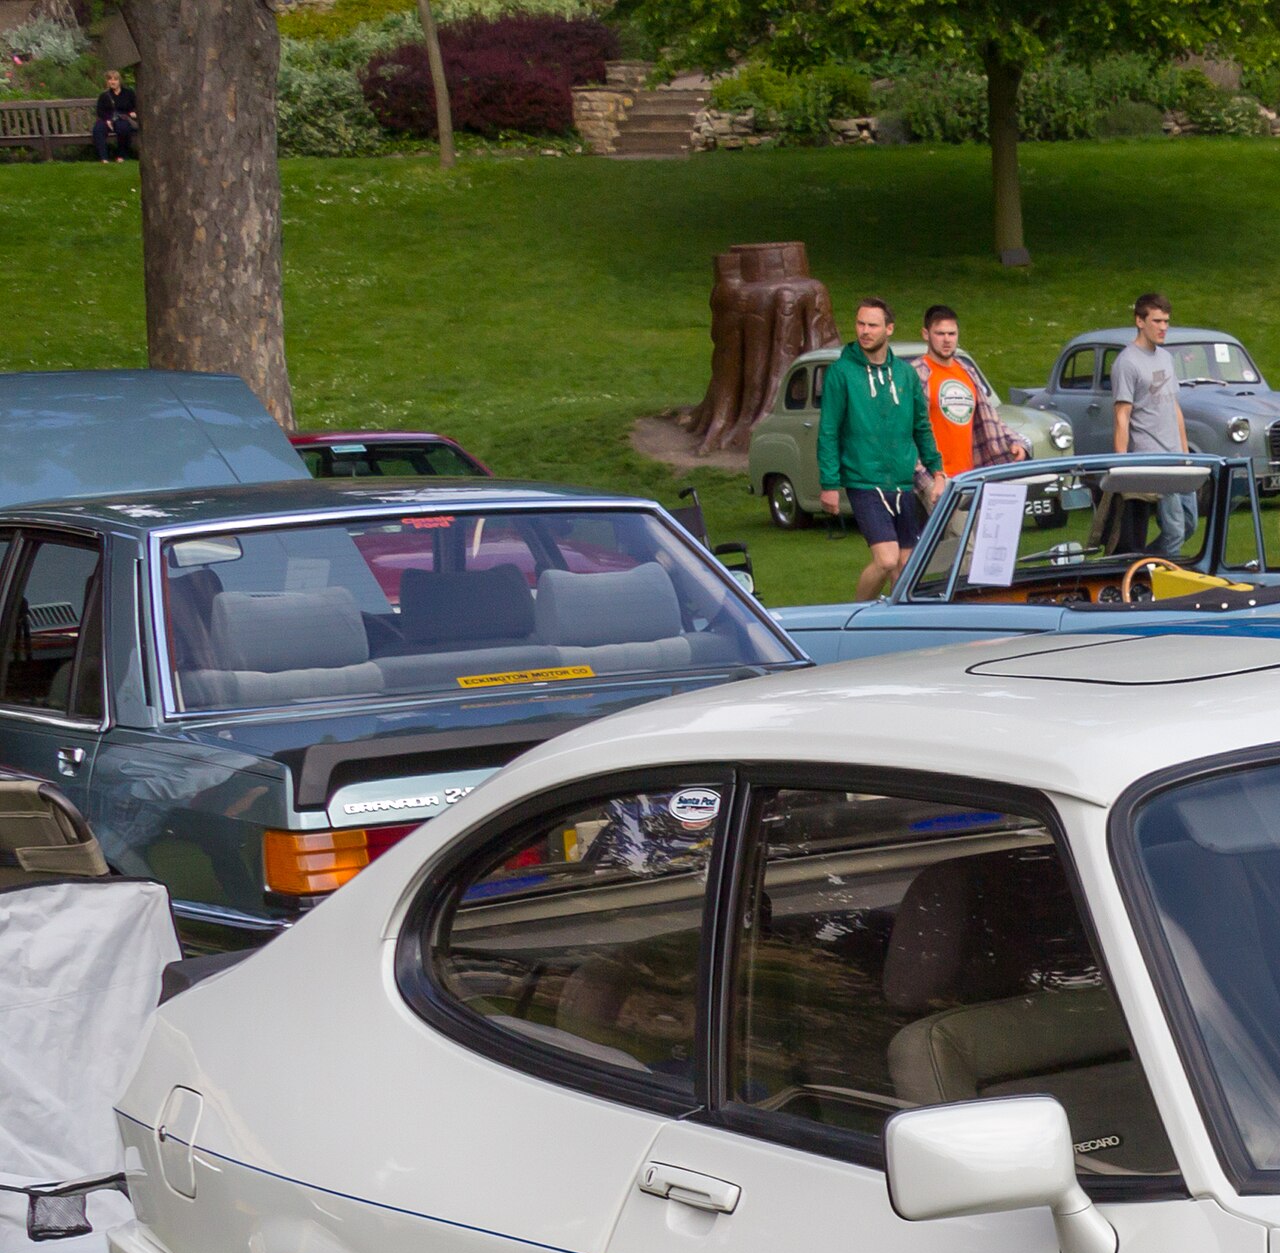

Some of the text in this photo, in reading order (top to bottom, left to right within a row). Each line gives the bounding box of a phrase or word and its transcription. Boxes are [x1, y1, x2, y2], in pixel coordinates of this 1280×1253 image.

[1025, 500, 1052, 514] 265
[463, 674, 528, 685] ECKINGTON
[530, 669, 570, 678] MOTOR
[343, 795, 439, 814] GRANADA
[677, 796, 717, 806] Santa Pod
[1072, 1135, 1120, 1154] RECARO
